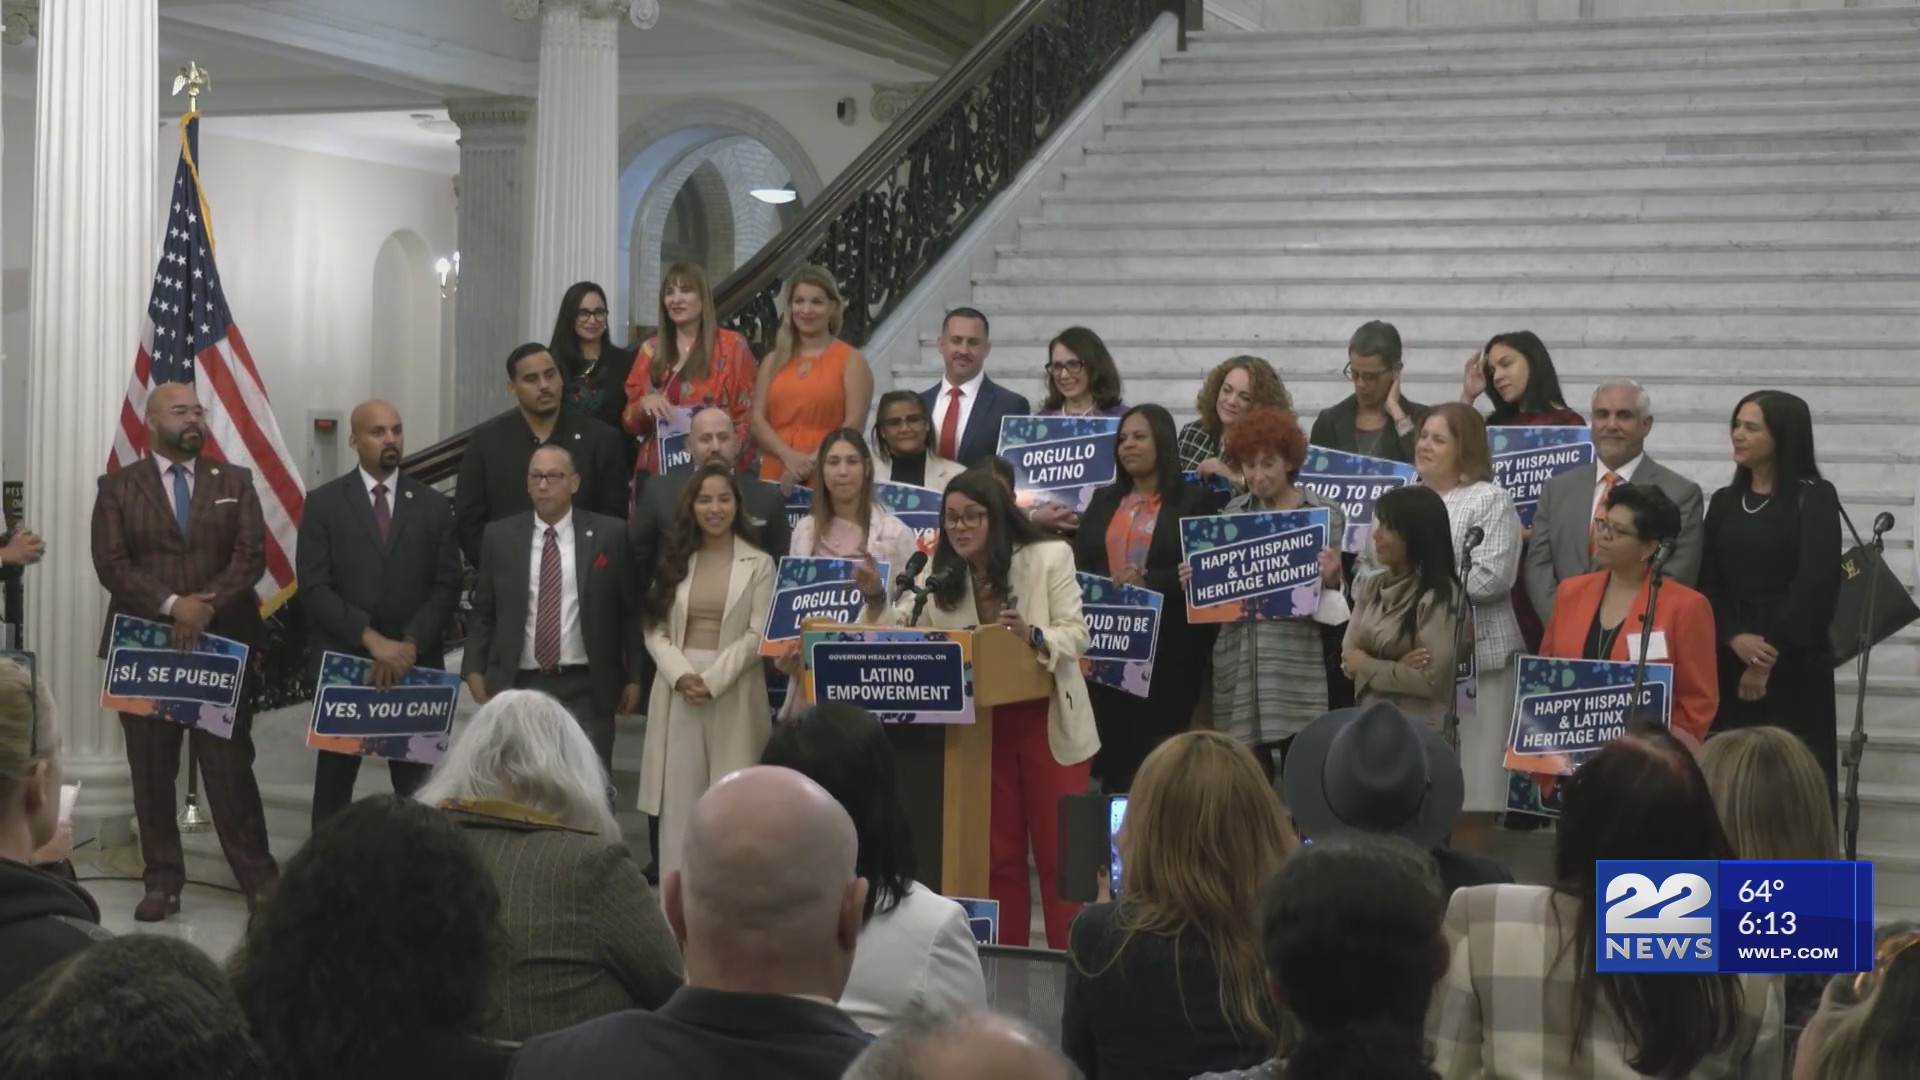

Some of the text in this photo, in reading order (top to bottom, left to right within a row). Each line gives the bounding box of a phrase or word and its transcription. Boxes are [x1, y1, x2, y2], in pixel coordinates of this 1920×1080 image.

[667, 450, 691, 468] AN!
[1023, 443, 1095, 467] ORGULLO
[1516, 450, 1580, 471] HISPANIC
[1028, 463, 1084, 484] LATINO
[1505, 467, 1554, 486] LATINX
[1346, 485, 1366, 500] TO
[1201, 533, 1313, 570] HAPPY HISPANIC
[1227, 554, 1290, 579] & LATINX
[1197, 562, 1319, 600] HERITAGE MONTH!
[792, 589, 860, 611] ORGULLO
[1083, 613, 1149, 633] OUD TO BE
[1090, 633, 1130, 651] ATINO
[828, 653, 947, 661] GOVERNOR HEALEY'S COUNCIL ON
[147, 666, 171, 683] SE
[175, 668, 235, 690] PUEDE!
[860, 667, 914, 683] LATINO
[827, 685, 950, 700] EMPOWERMENT
[325, 702, 448, 720] YES, YOU CAN!
[1534, 698, 1581, 716] HAPPY
[1559, 710, 1624, 729] & LATINX
[1523, 729, 1594, 748] HERITAGE
